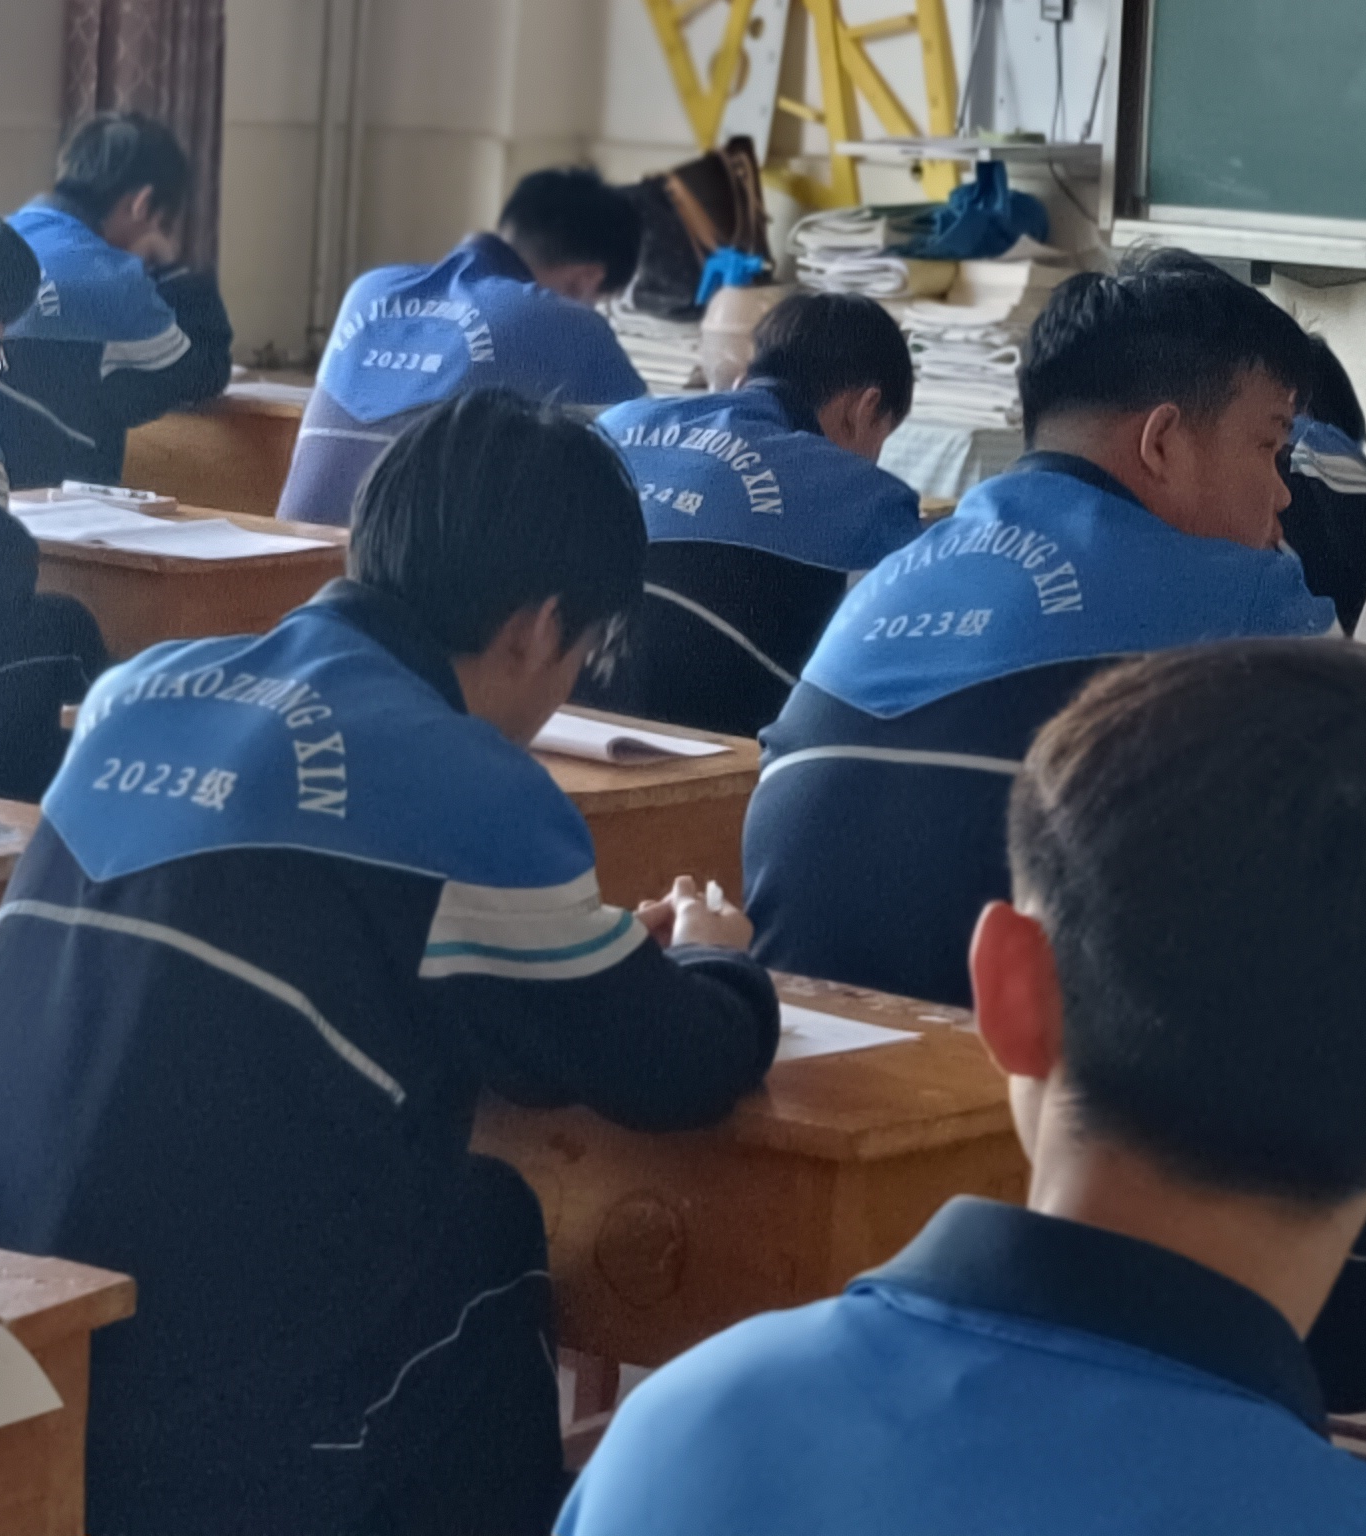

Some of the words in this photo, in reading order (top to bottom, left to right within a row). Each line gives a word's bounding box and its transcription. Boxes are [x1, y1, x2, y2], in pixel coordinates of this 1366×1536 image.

[619, 422, 681, 448] JIAO
[679, 426, 762, 472] ZHONG
[740, 468, 783, 515] XIN
[955, 518, 1059, 570] ZHONG
[1032, 560, 1085, 616] XIN
[862, 607, 995, 643] 2023级
[91, 757, 239, 813] 2023级
[122, 666, 226, 706] JIAO
[214, 672, 334, 730] ZHONG
[292, 730, 349, 819] XIN
